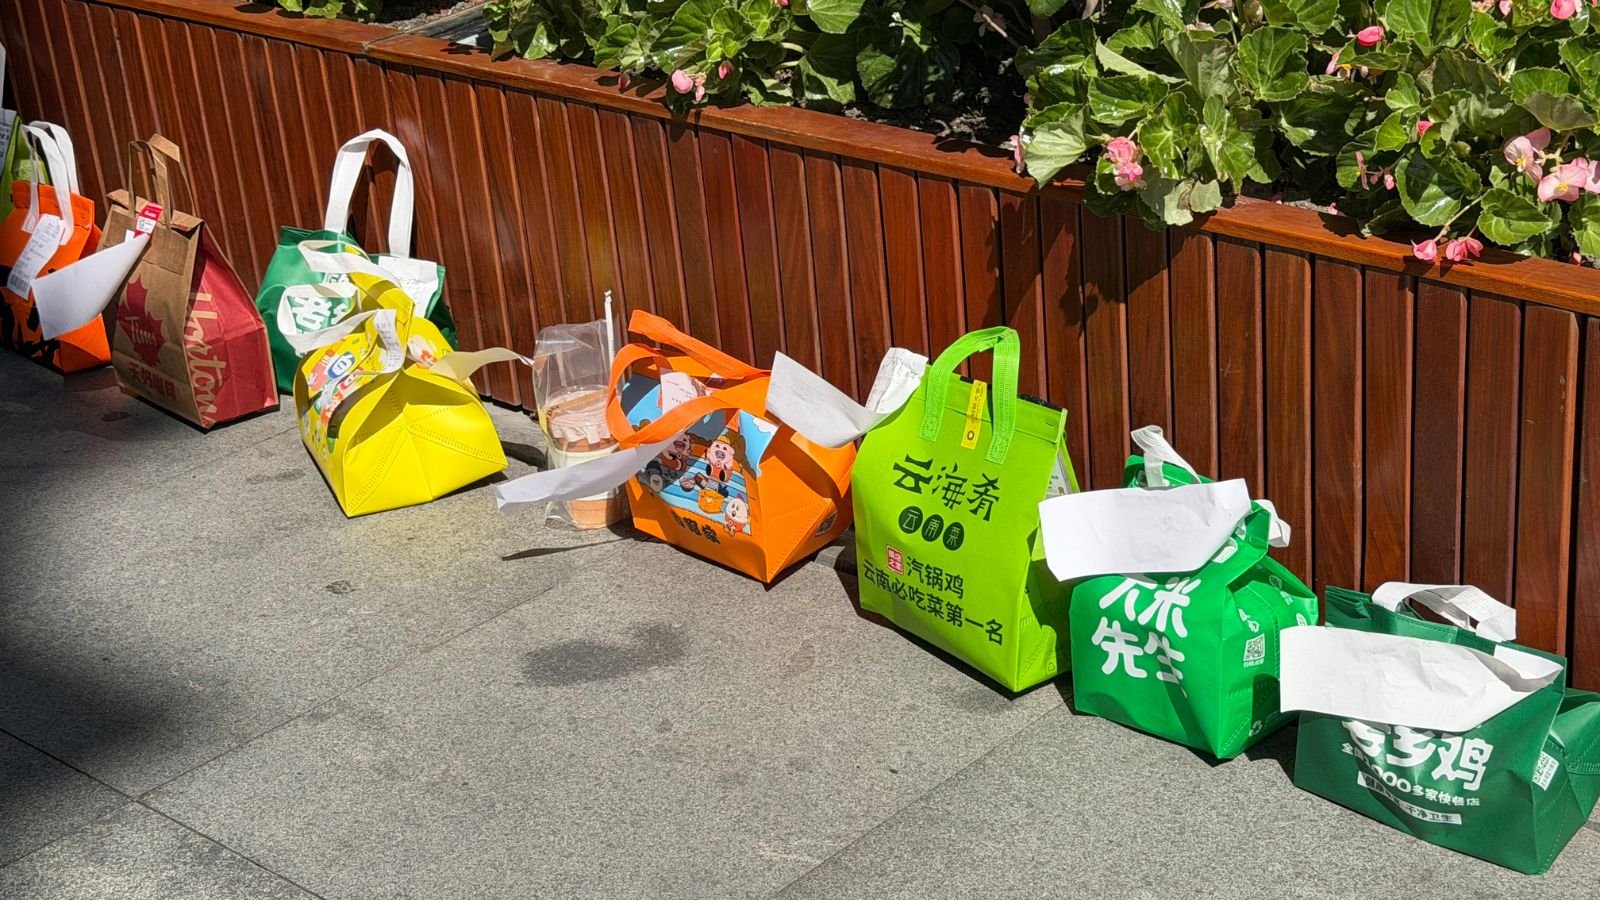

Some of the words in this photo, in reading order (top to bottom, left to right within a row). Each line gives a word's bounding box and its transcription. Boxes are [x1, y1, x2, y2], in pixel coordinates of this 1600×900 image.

[892, 453, 1000, 522] 云海肴
[901, 507, 962, 548] 云南菜
[863, 559, 1003, 646] 云南必吃菜第一名
[906, 556, 964, 600] 汽锅鸡
[1091, 616, 1185, 684] 先生
